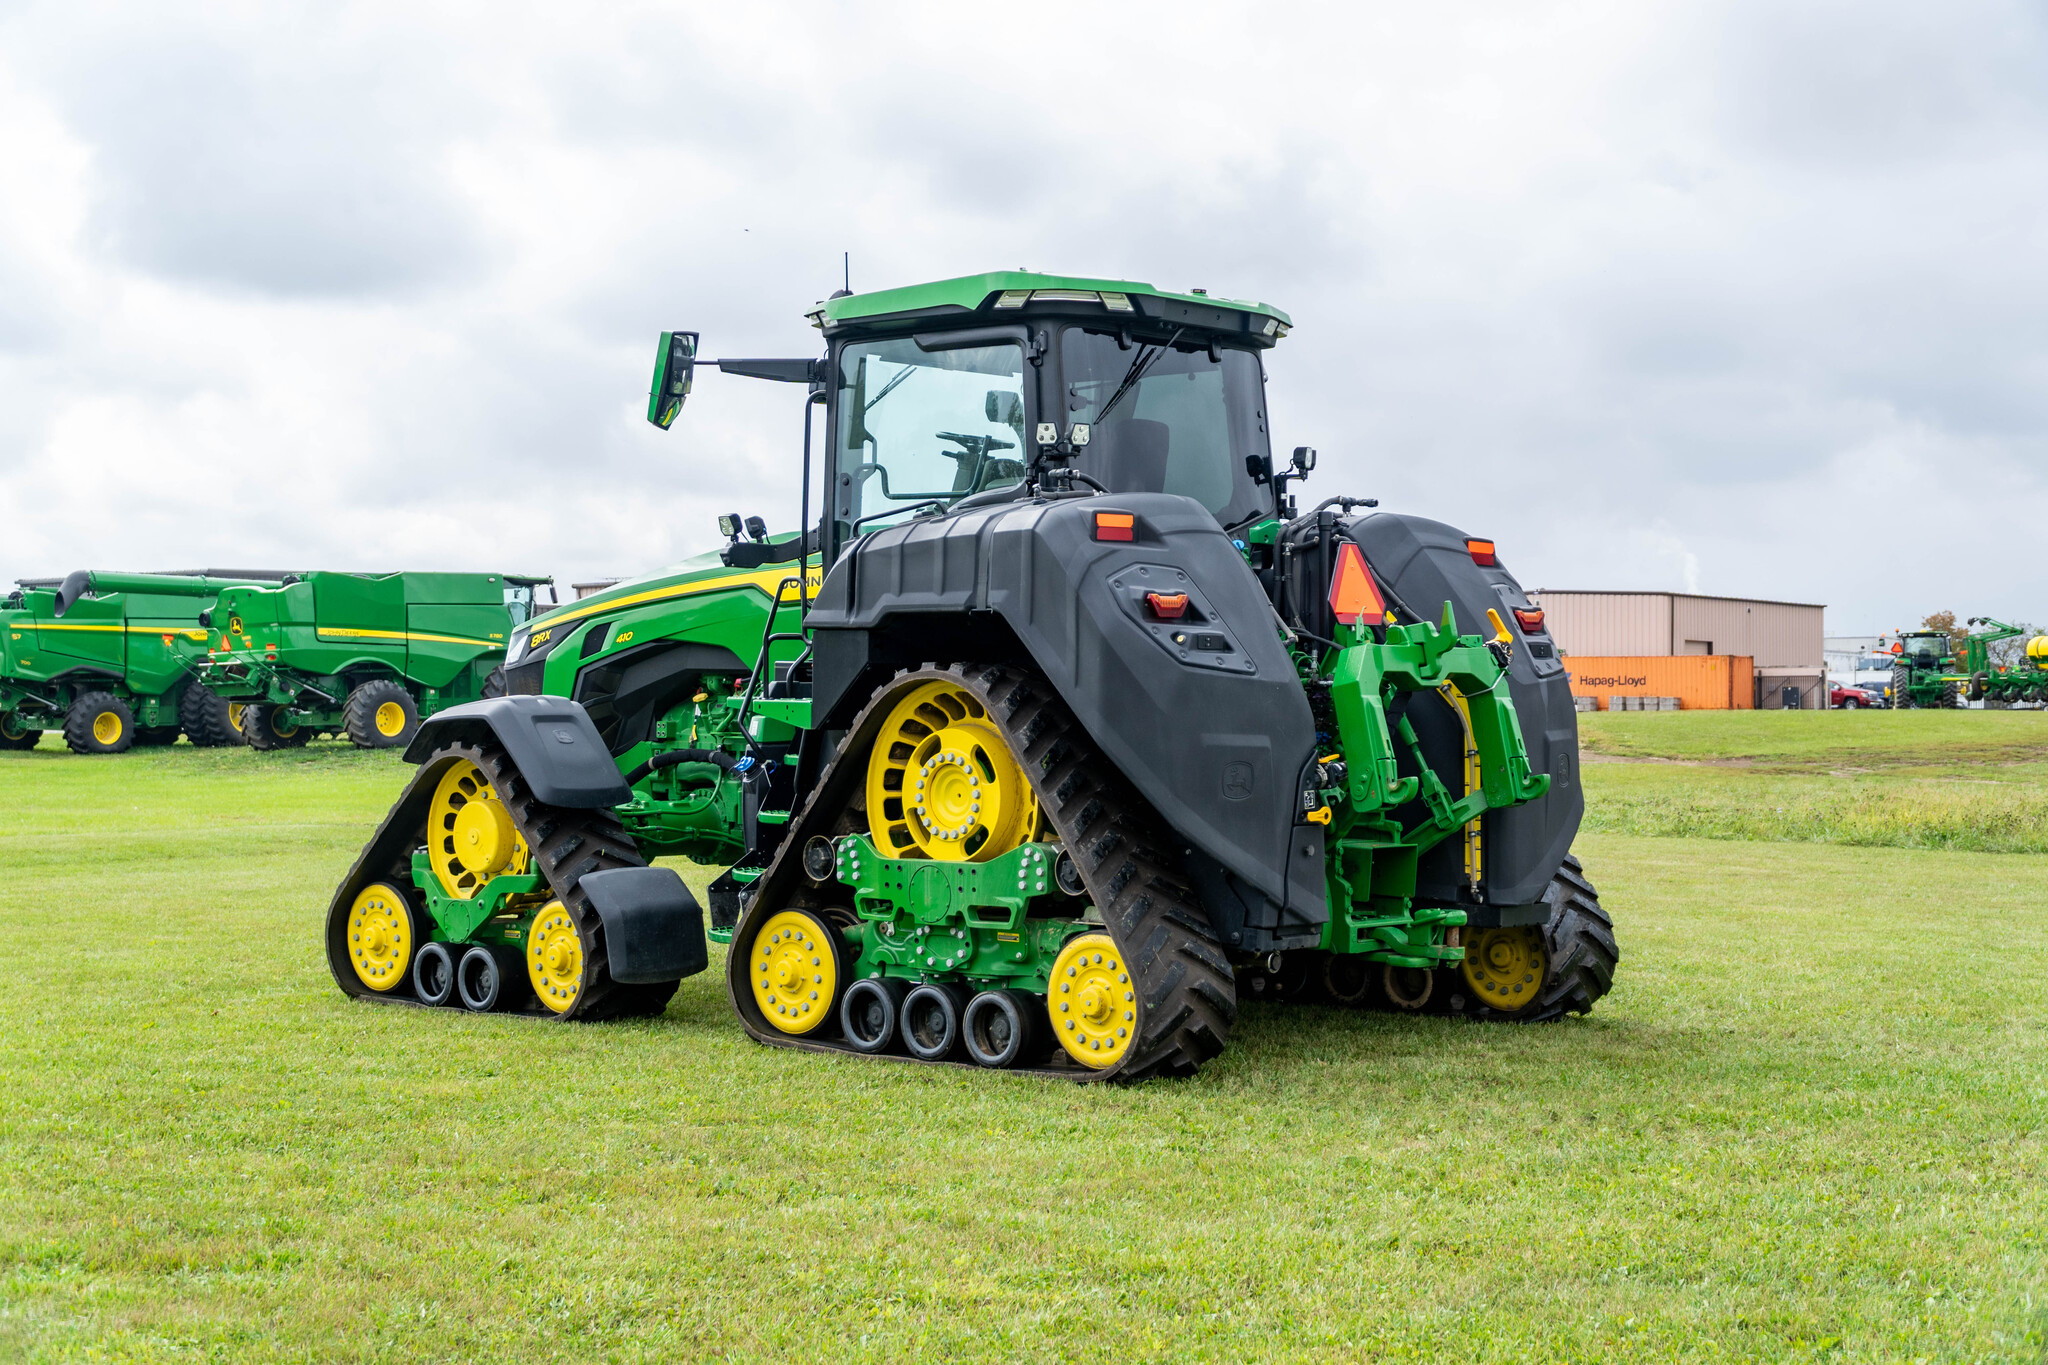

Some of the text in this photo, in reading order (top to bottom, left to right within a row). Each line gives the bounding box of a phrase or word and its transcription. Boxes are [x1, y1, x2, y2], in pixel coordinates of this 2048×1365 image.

[530, 629, 552, 648] 8RX
[615, 631, 634, 644] 410
[1579, 675, 1647, 687] Hapag-Lloyd
